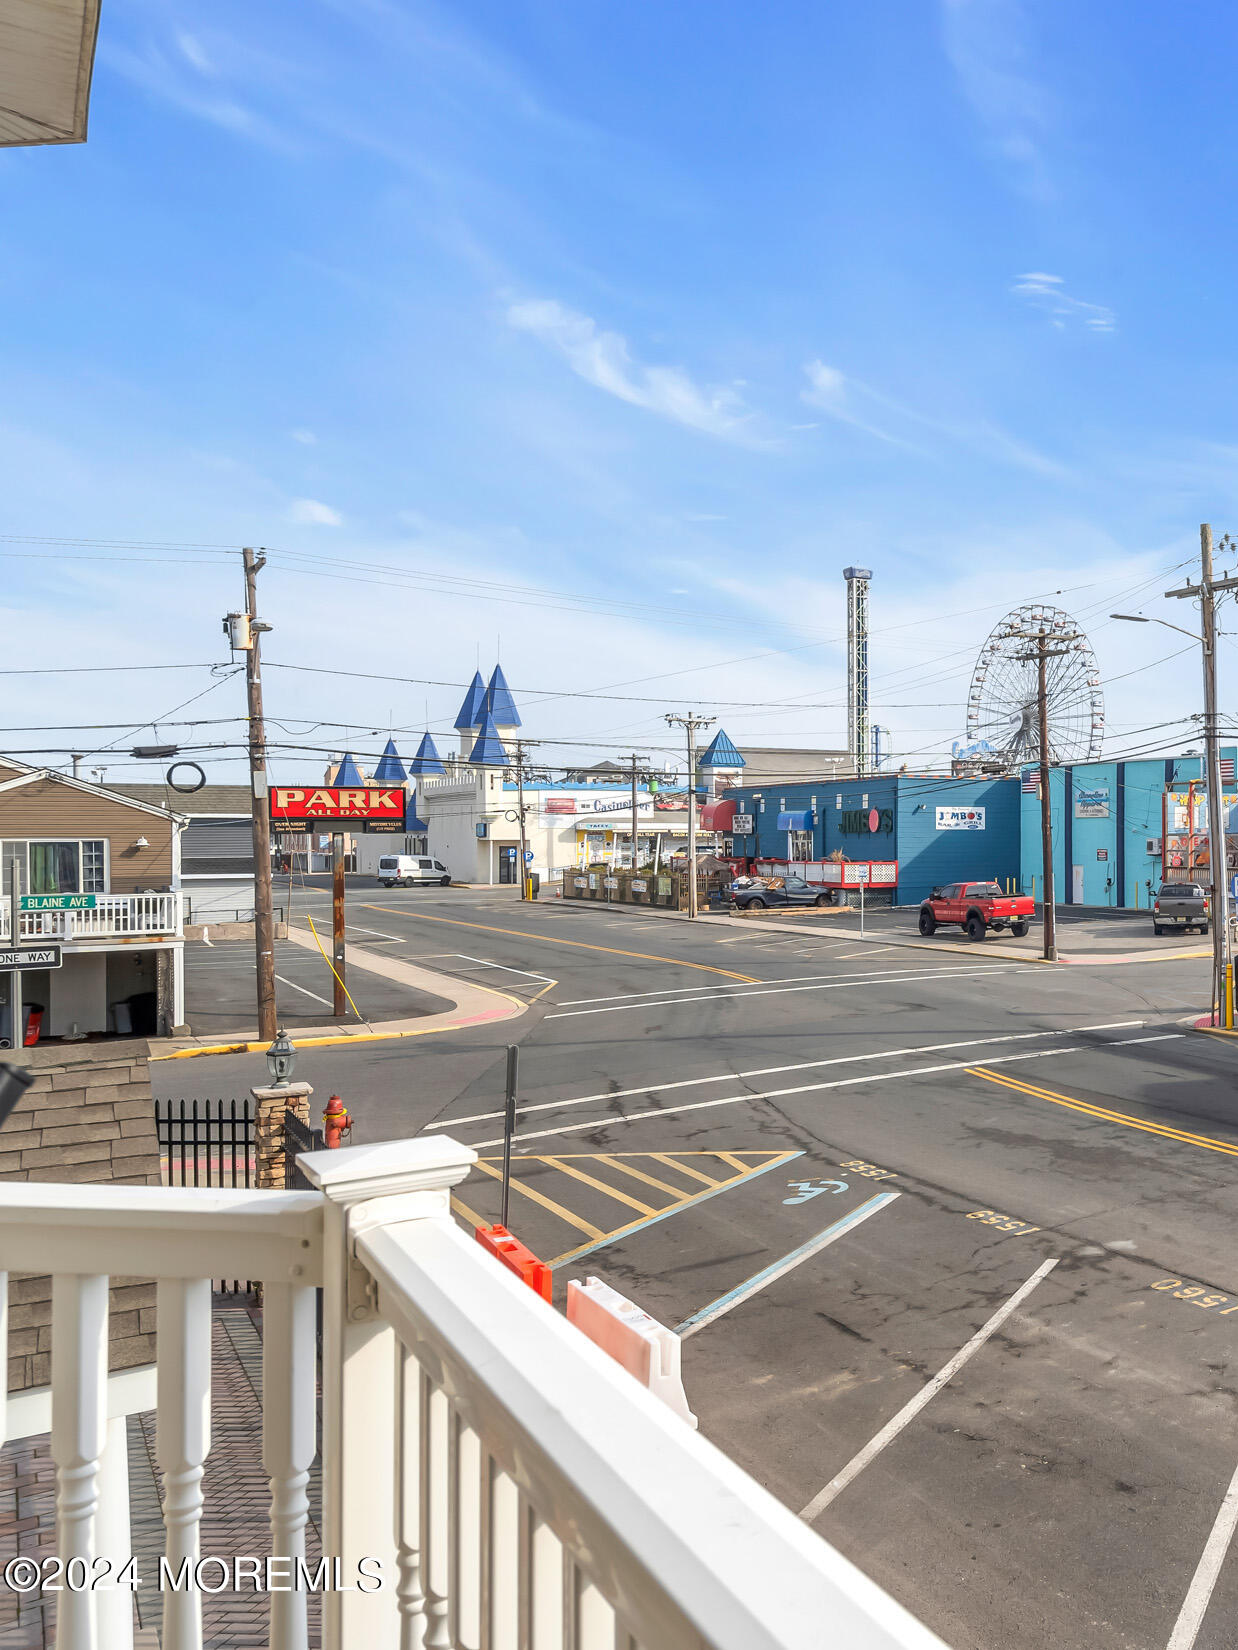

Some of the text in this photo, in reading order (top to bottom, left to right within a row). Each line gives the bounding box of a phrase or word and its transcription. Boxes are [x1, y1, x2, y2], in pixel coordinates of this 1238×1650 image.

[277, 790, 398, 808] PARK
[27, 897, 88, 908] BLAINE AVE
[0, 952, 51, 964] ONE WAY
[839, 1160, 899, 1181] 1558
[965, 1210, 1041, 1236] 1559
